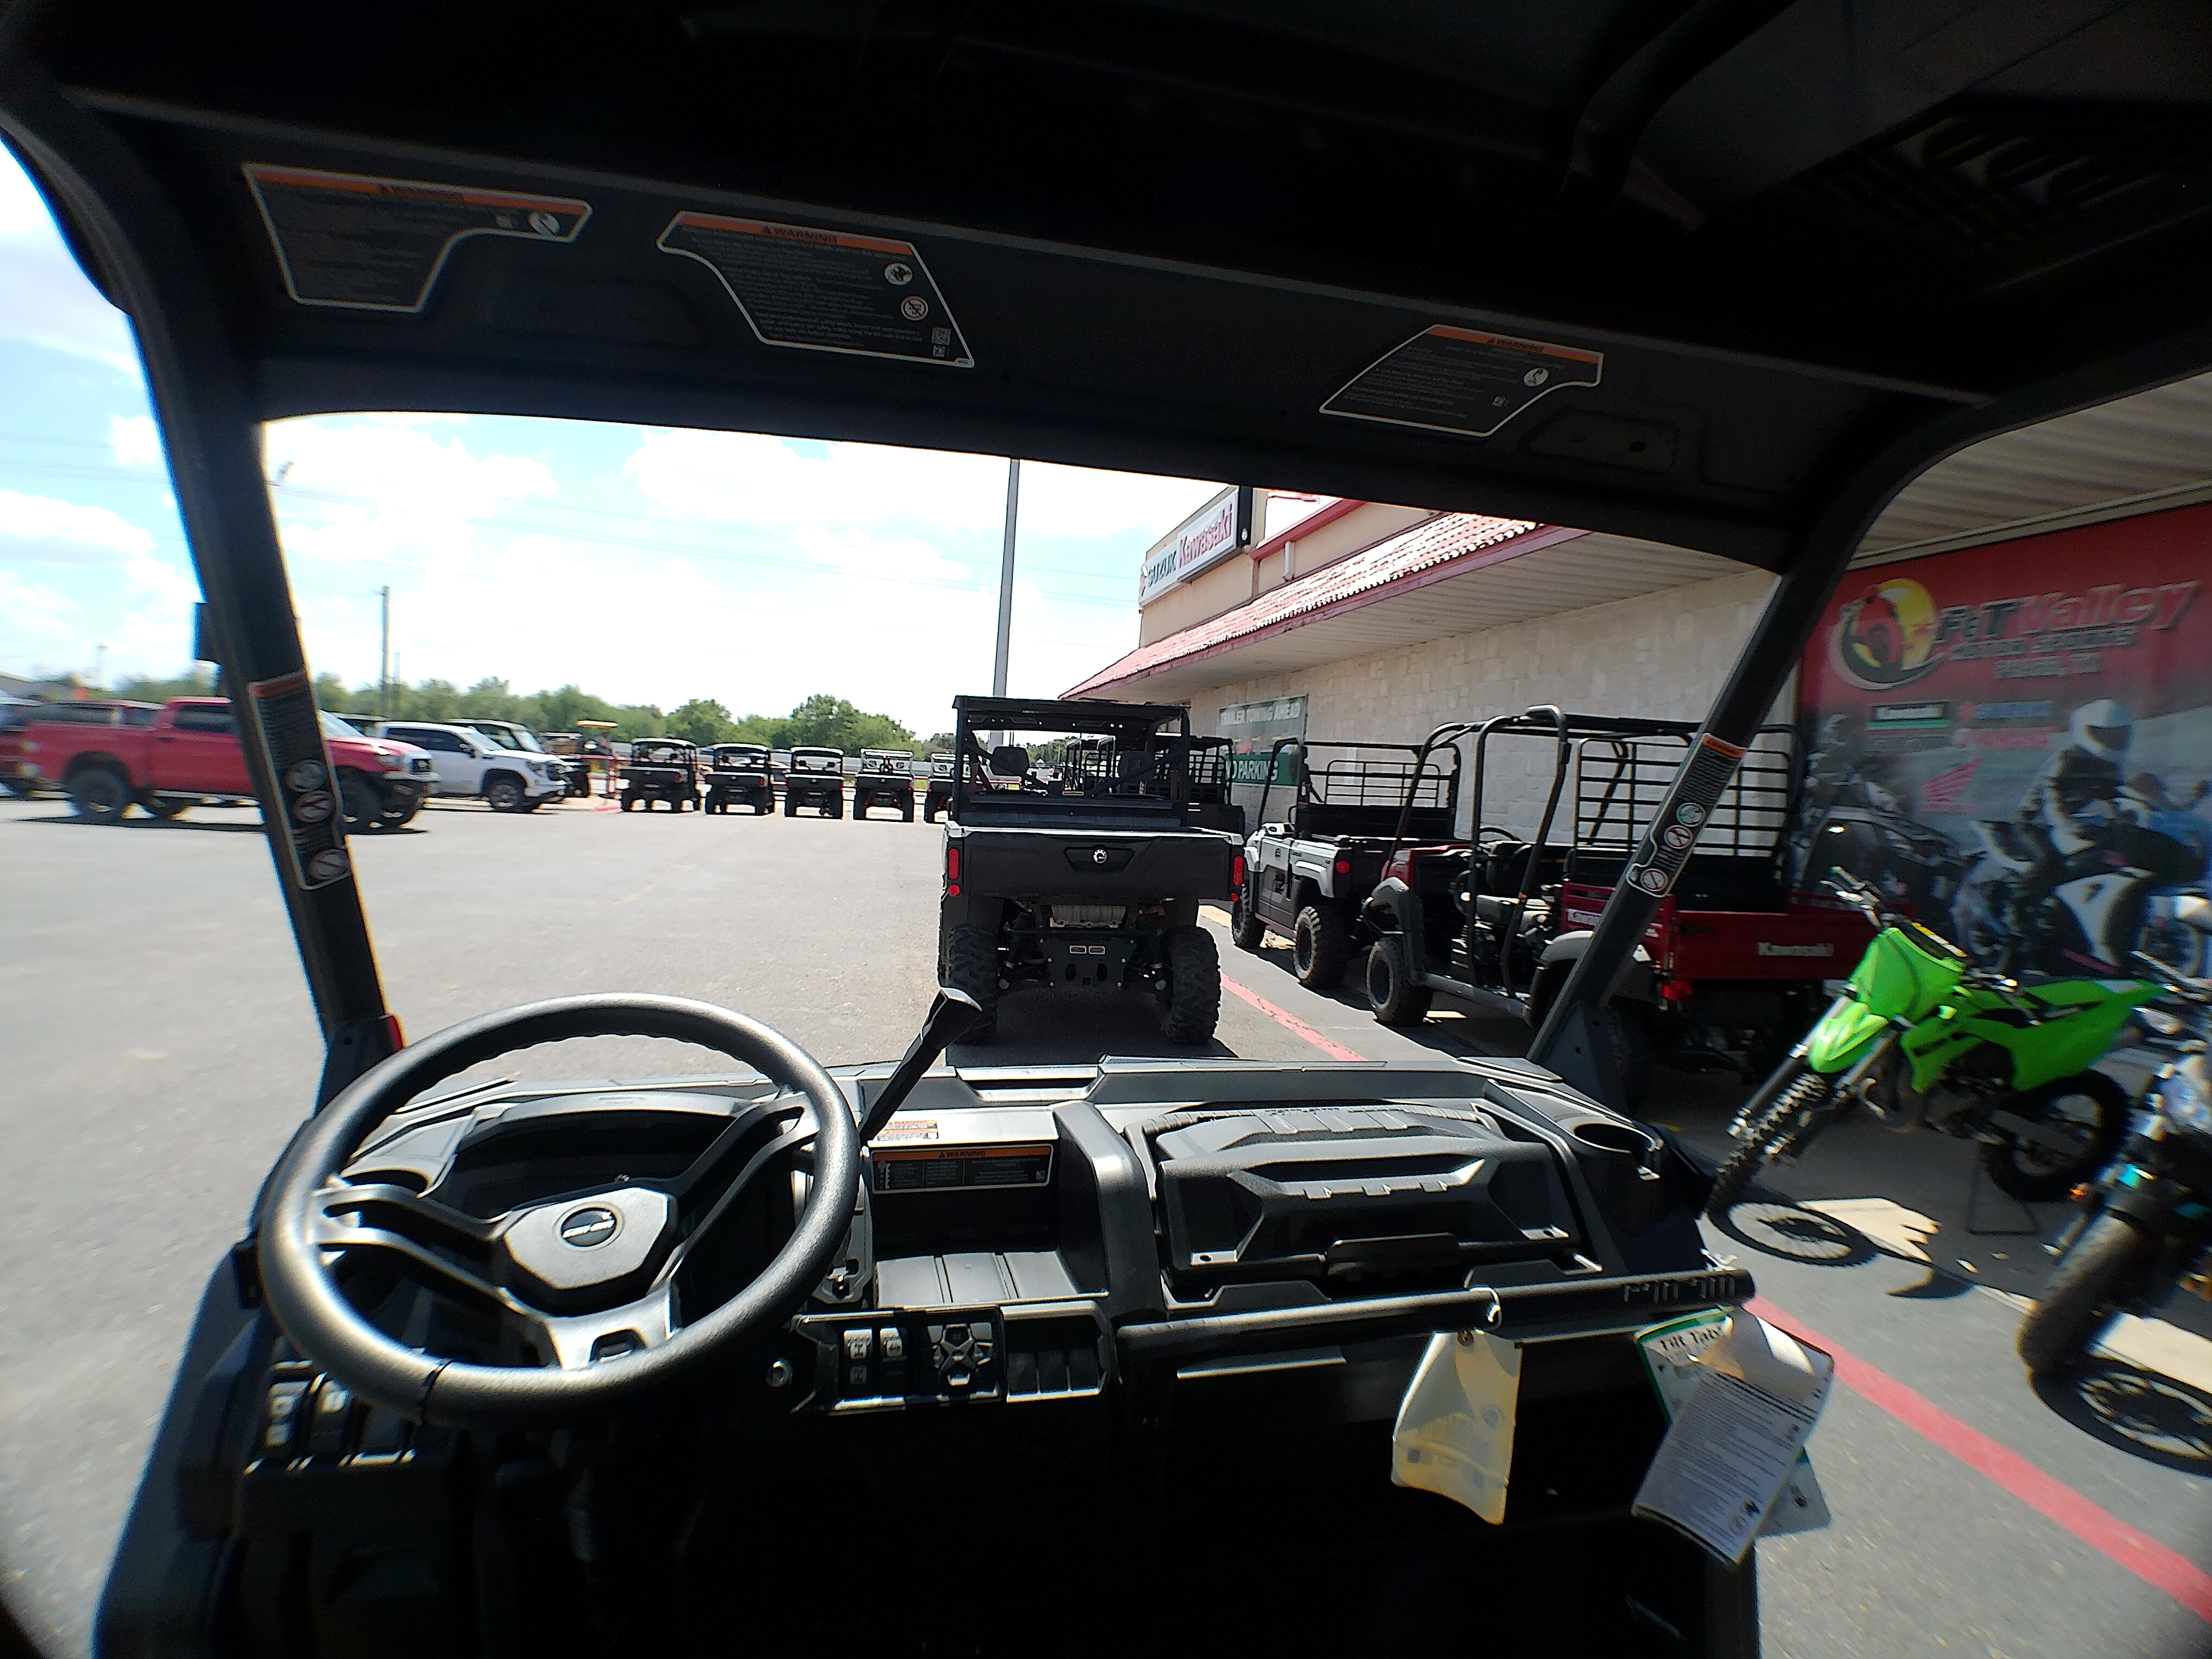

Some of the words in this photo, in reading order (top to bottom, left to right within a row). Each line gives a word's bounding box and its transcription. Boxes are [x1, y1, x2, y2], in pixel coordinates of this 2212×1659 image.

[1179, 504, 1233, 568] Kawasaki
[1147, 550, 1177, 588] SUZUK
[1238, 760, 1279, 781] PARKING
